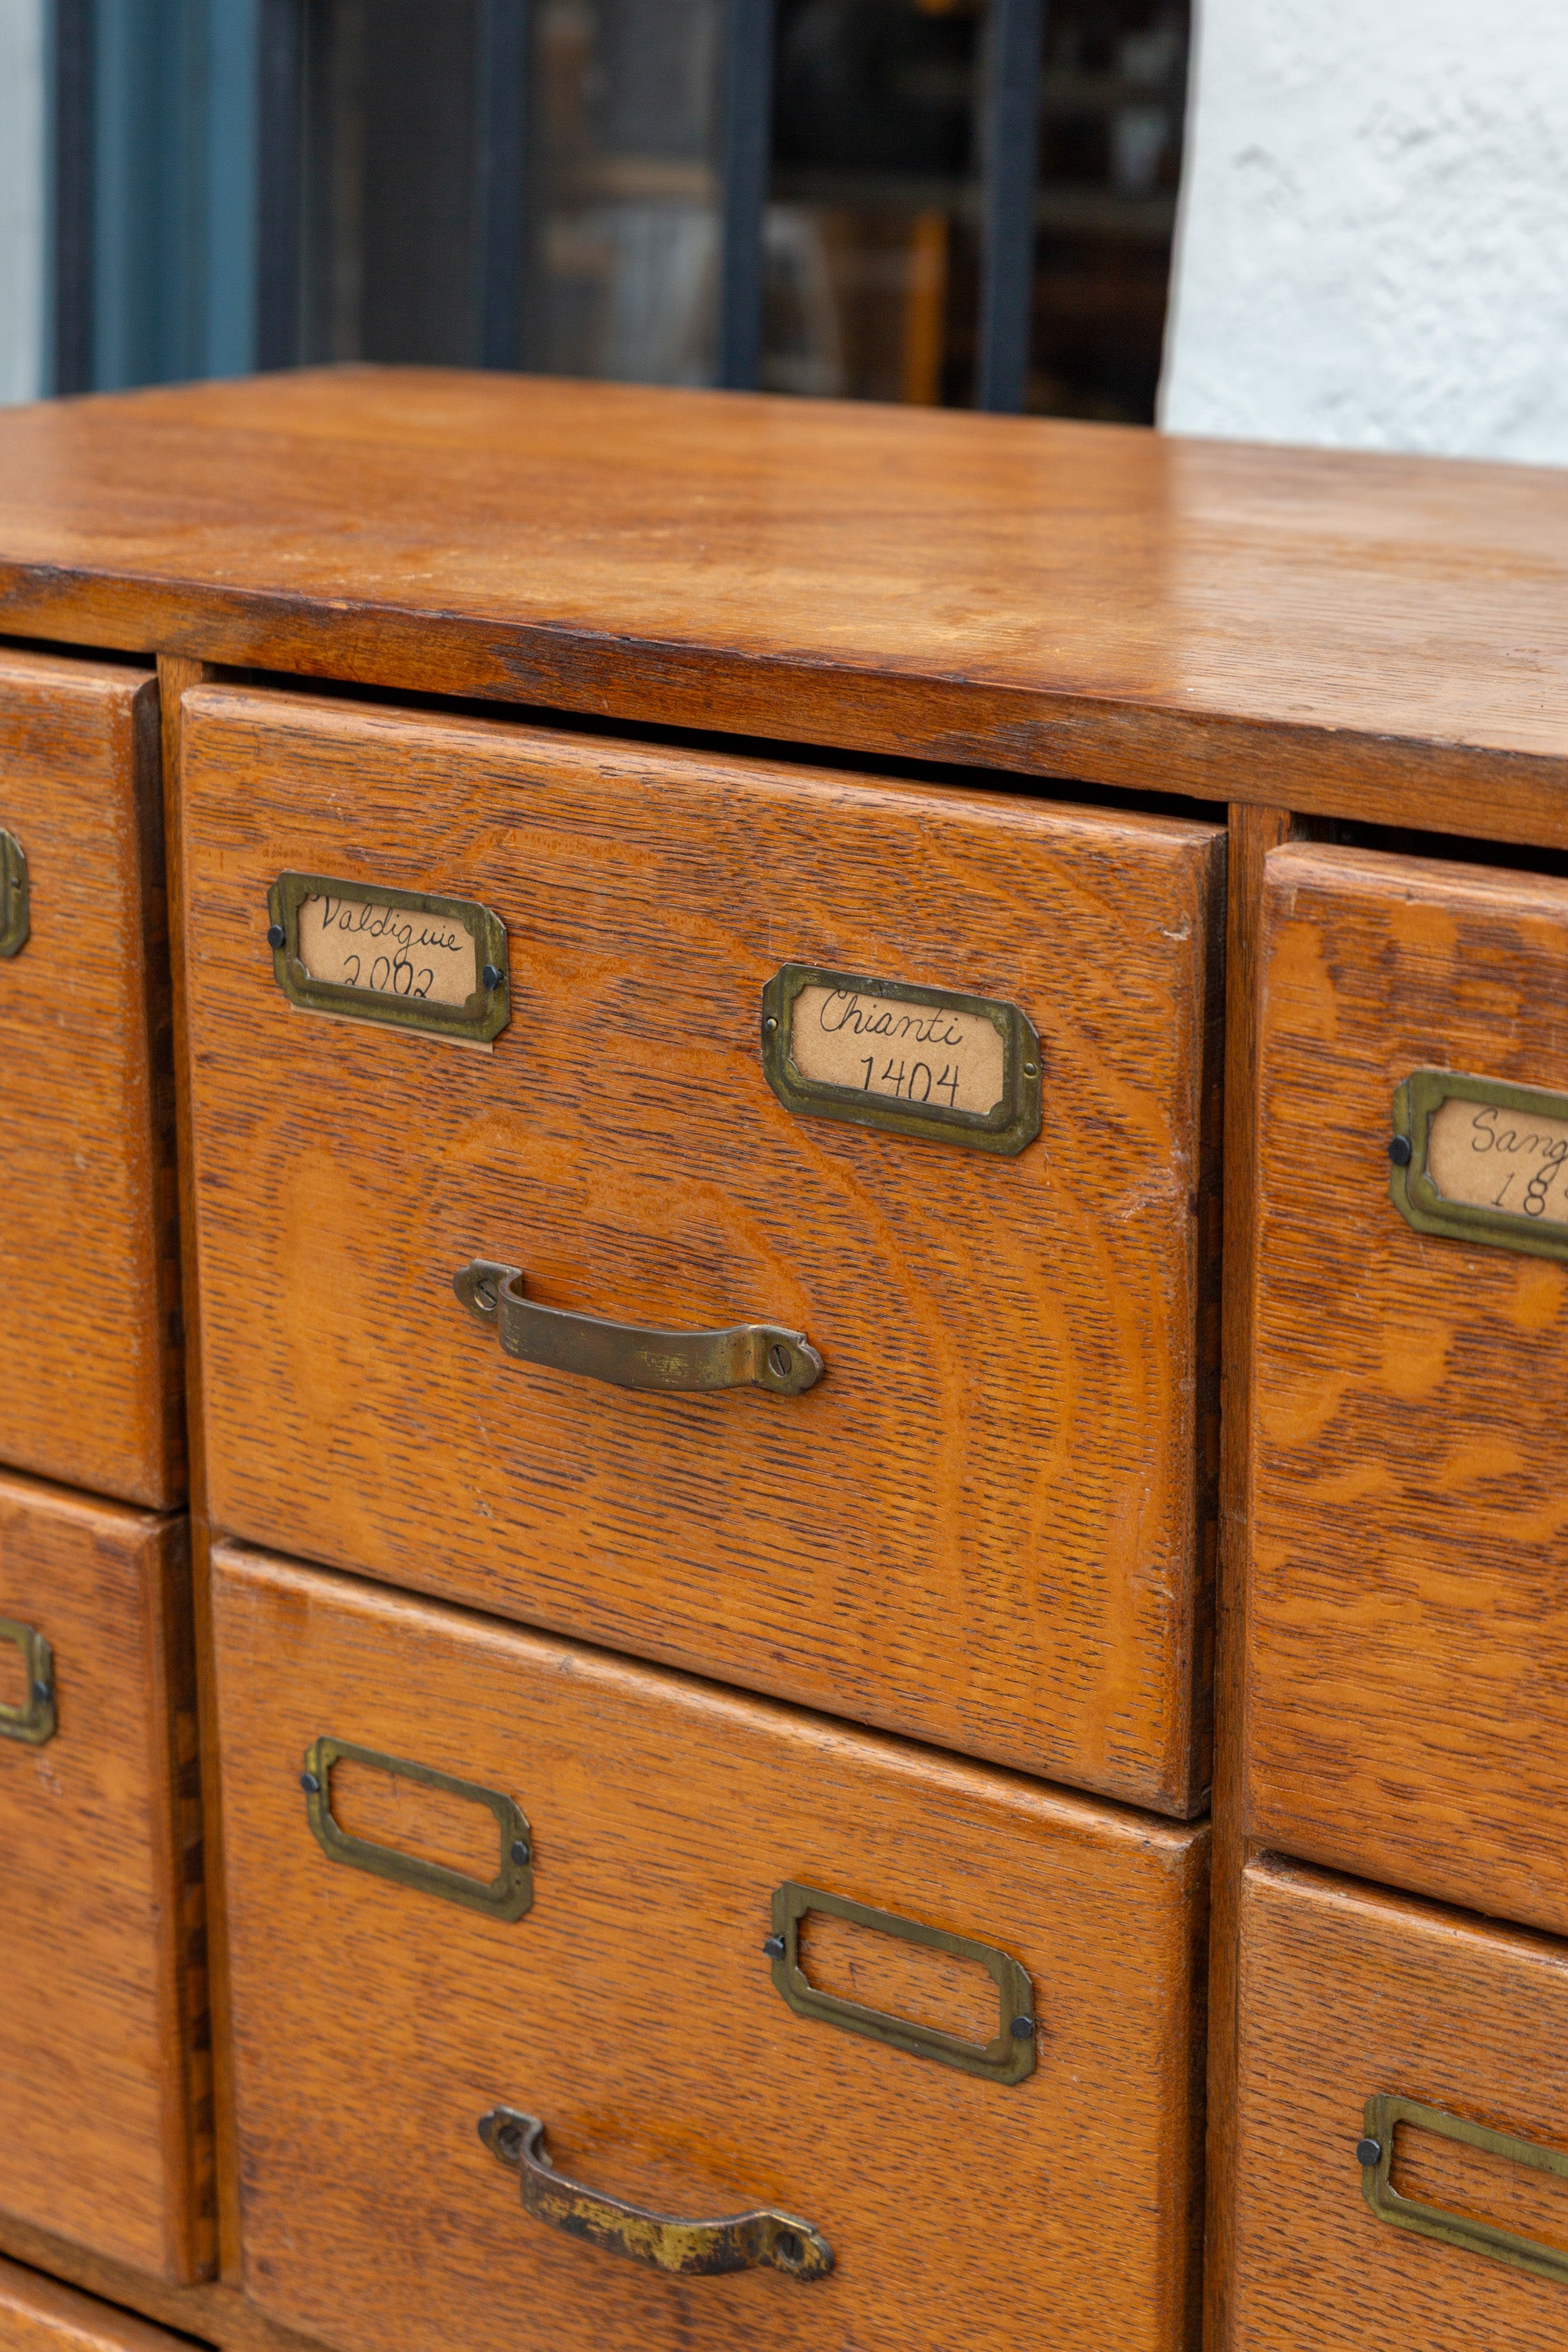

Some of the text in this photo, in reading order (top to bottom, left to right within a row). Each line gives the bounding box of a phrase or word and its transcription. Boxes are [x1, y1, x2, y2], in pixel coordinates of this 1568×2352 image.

[343, 955, 434, 998] 2002
[820, 989, 964, 1045] Chianti
[861, 1056, 960, 1107] 1404
[1491, 1173, 1568, 1218] 18
